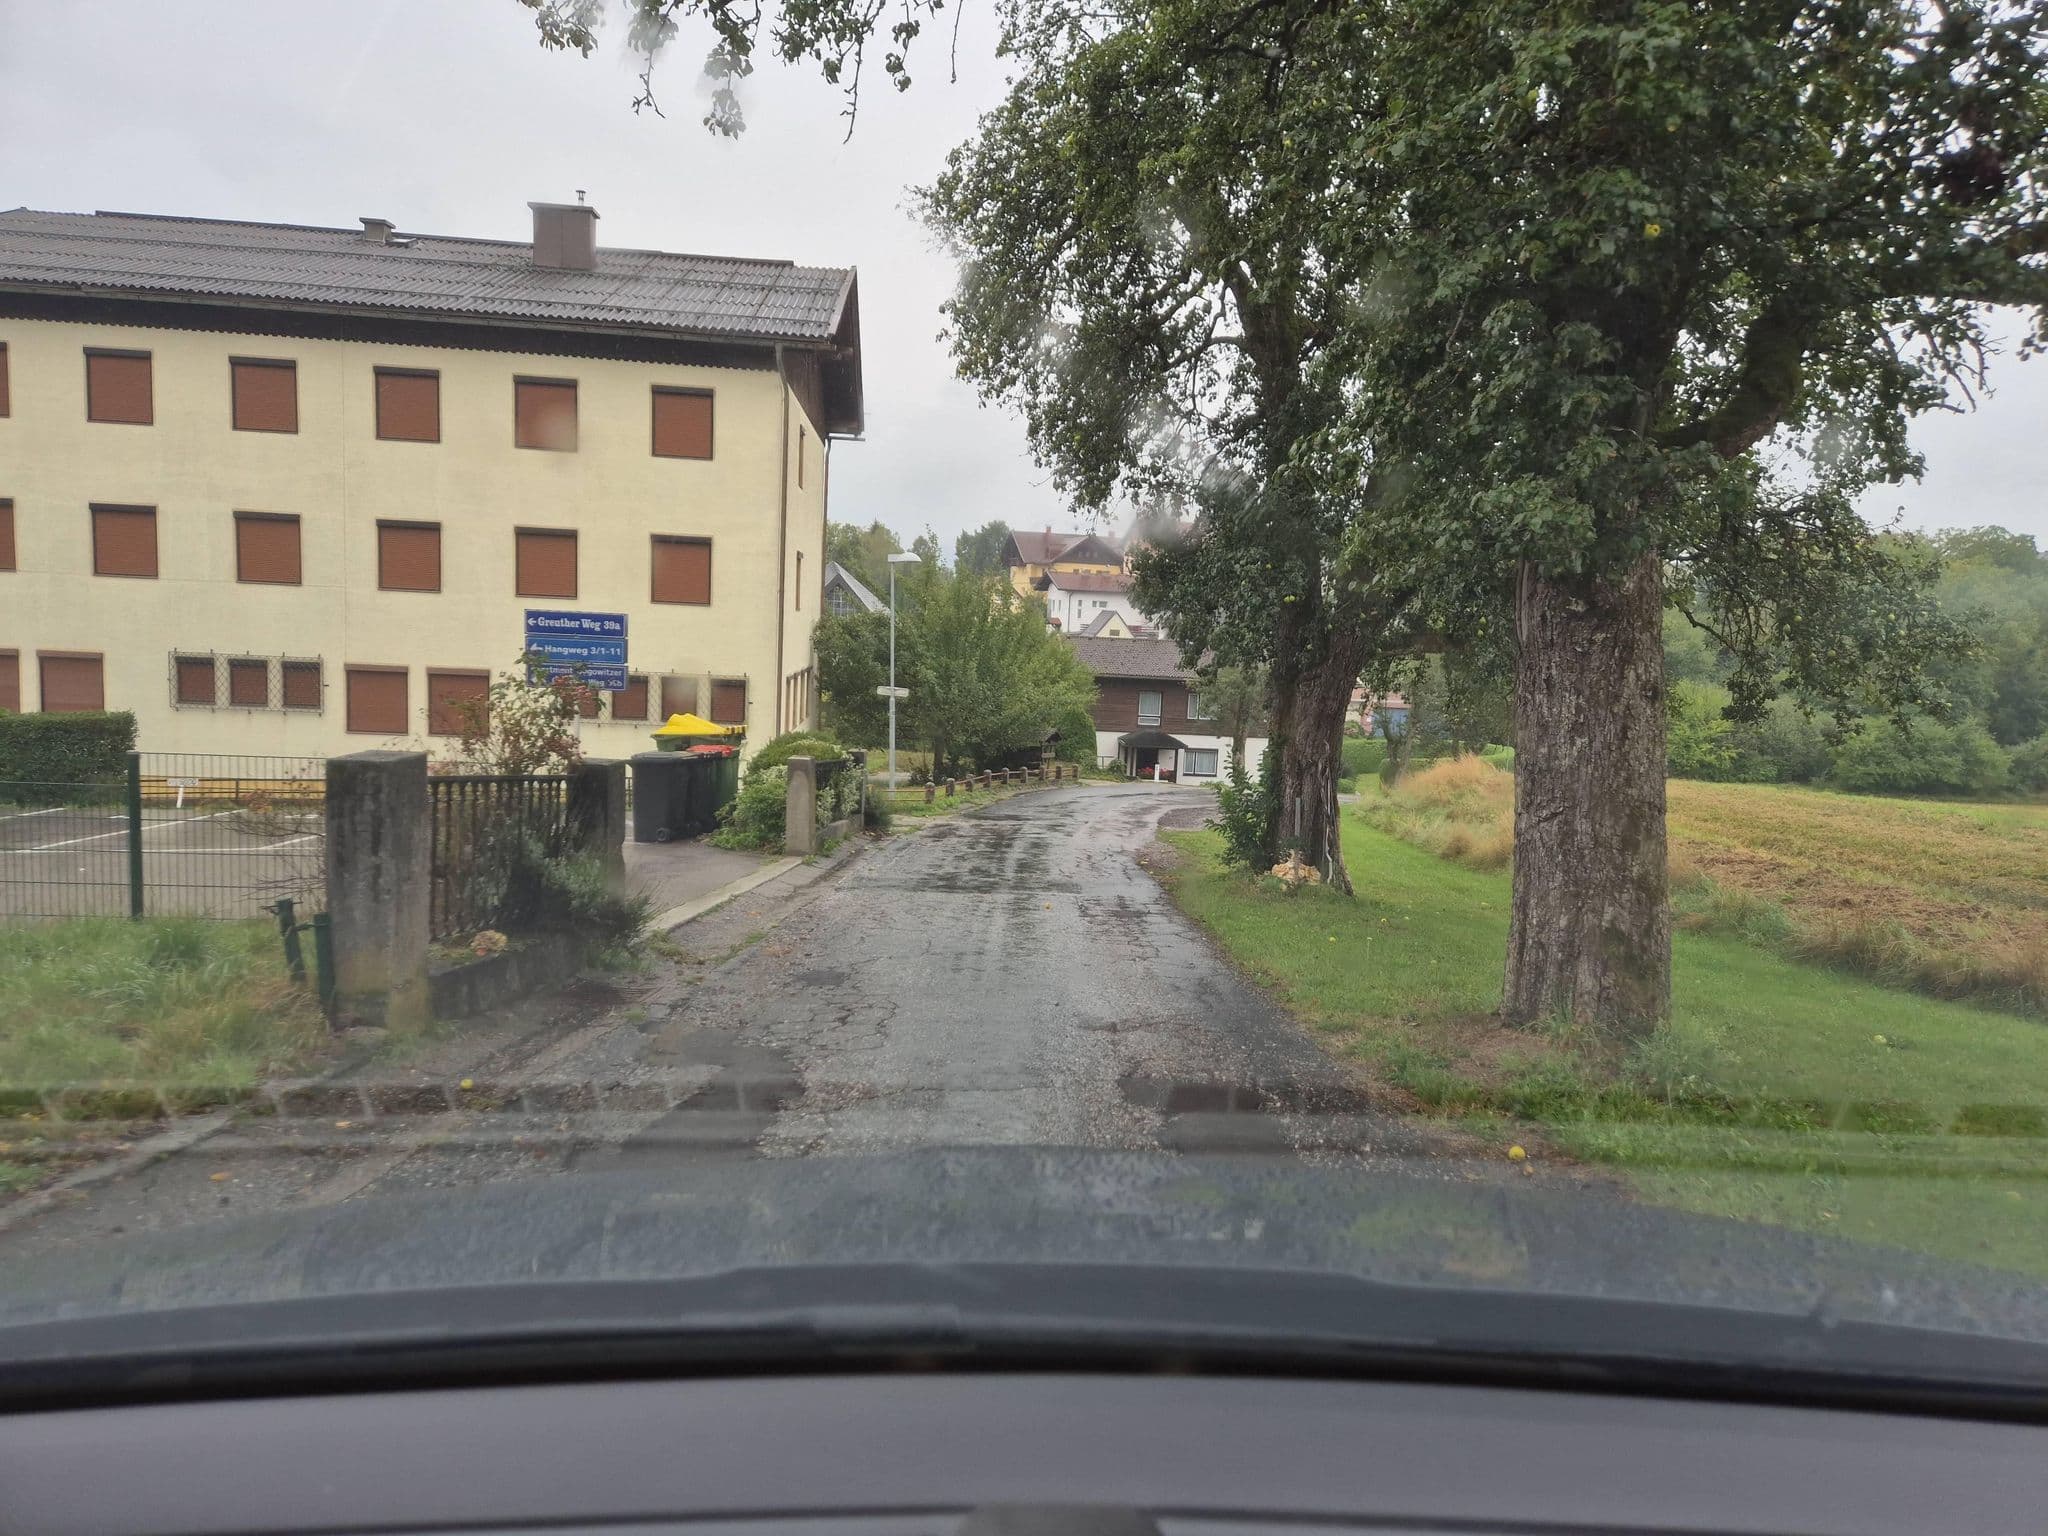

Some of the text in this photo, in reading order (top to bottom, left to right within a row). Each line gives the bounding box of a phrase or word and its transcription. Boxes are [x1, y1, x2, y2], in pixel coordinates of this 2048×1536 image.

[581, 618, 601, 632] Weg
[603, 620, 621, 630] 39a
[544, 645, 621, 656] Hangweg 3/1-11
